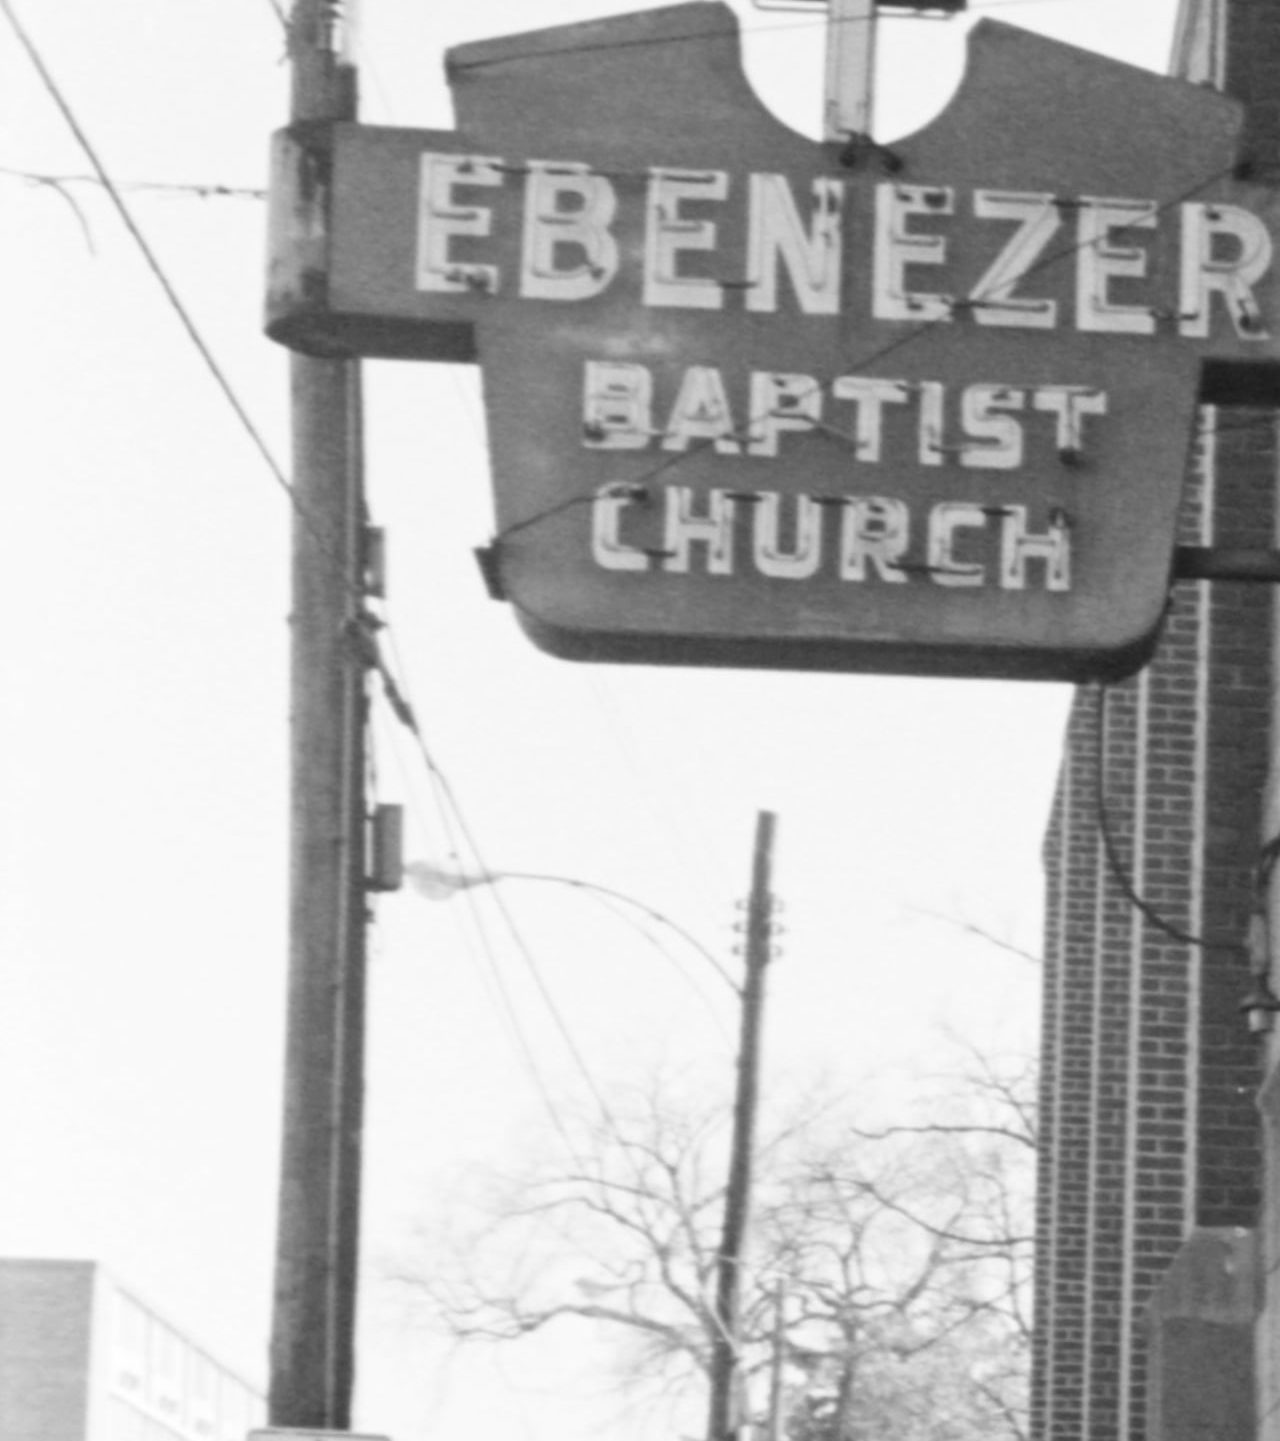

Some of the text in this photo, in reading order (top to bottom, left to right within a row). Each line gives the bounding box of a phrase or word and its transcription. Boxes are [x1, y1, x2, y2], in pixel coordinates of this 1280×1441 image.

[415, 152, 1273, 341] EBENEZER
[582, 359, 1107, 470] BAPTIST
[590, 479, 1074, 592] CHURCH
